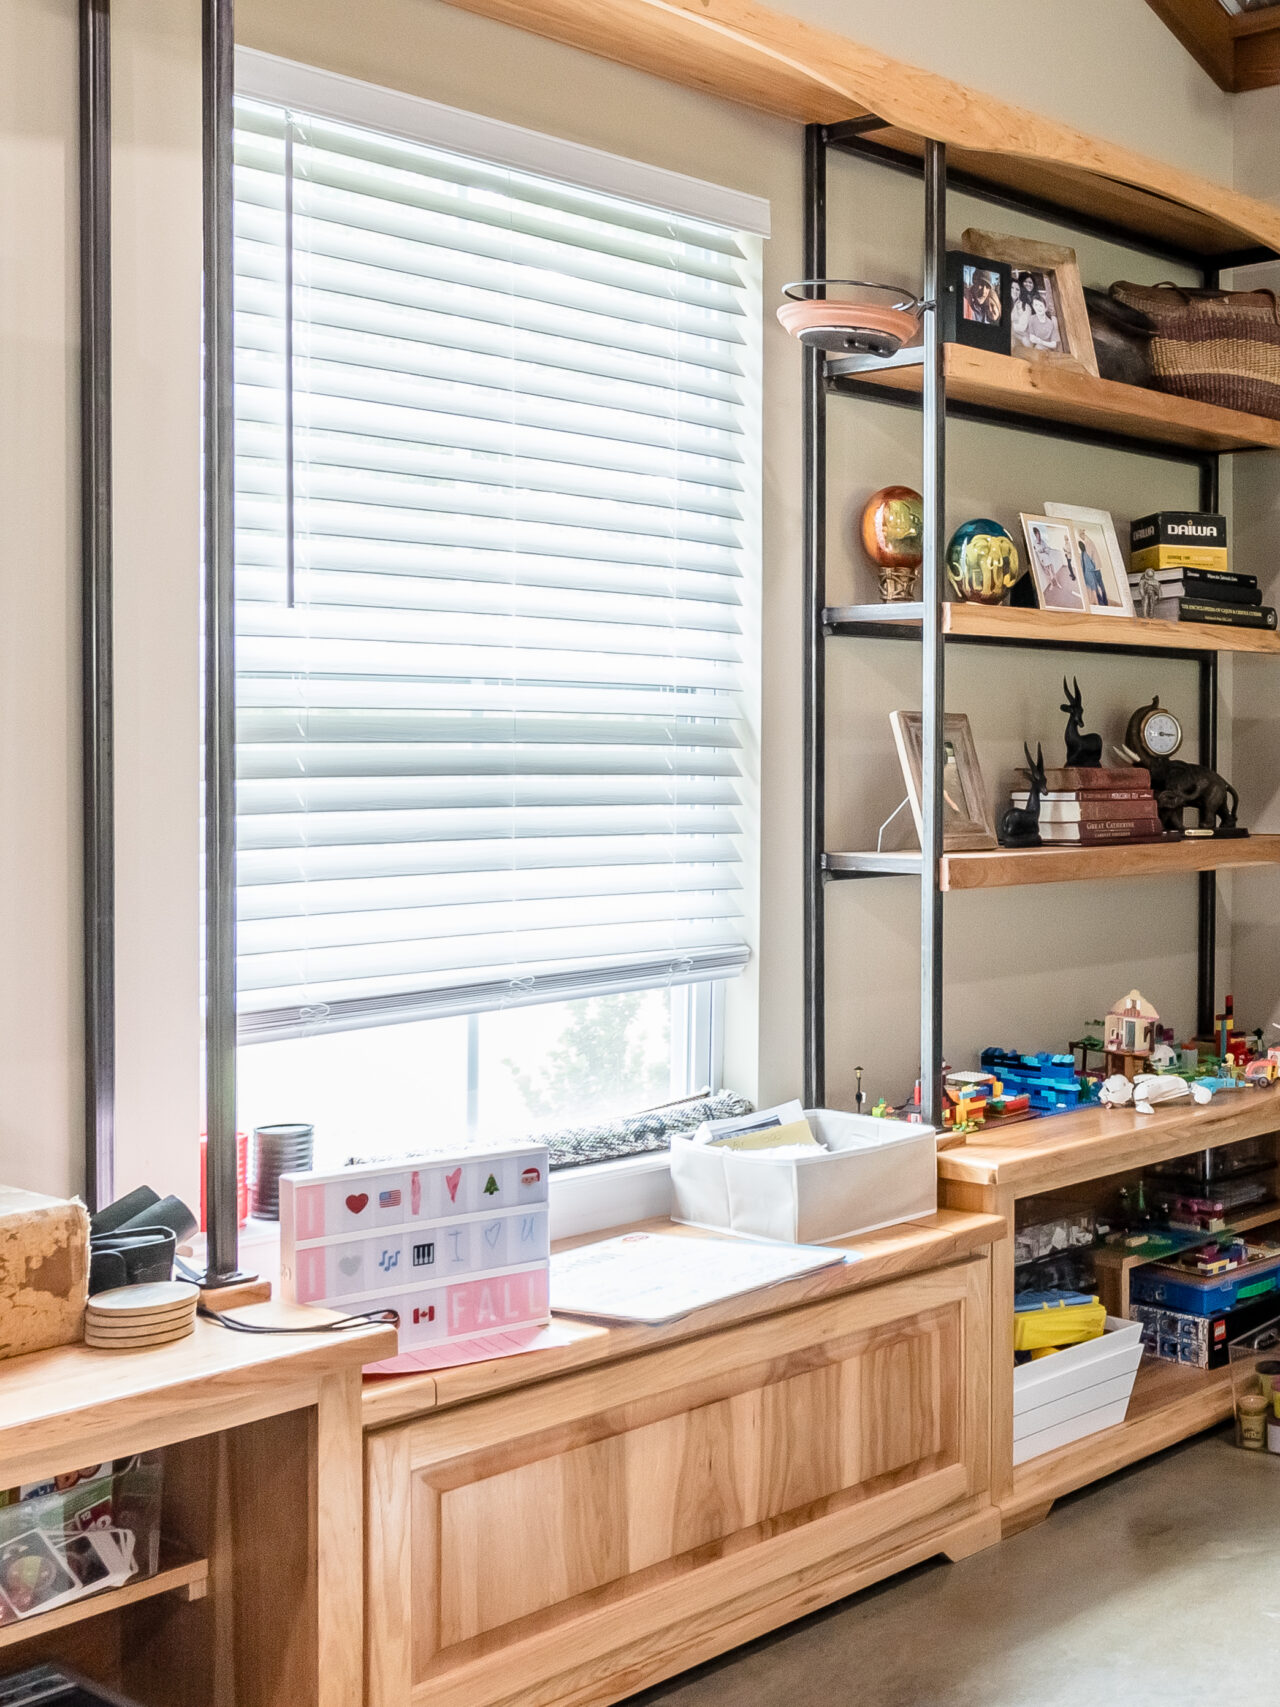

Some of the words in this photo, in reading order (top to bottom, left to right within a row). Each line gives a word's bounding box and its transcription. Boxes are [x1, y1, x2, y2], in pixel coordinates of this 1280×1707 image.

[1133, 525, 1154, 541] DAIWA
[1168, 520, 1217, 536] DAIWA
[452, 1277, 543, 1330] FALL
